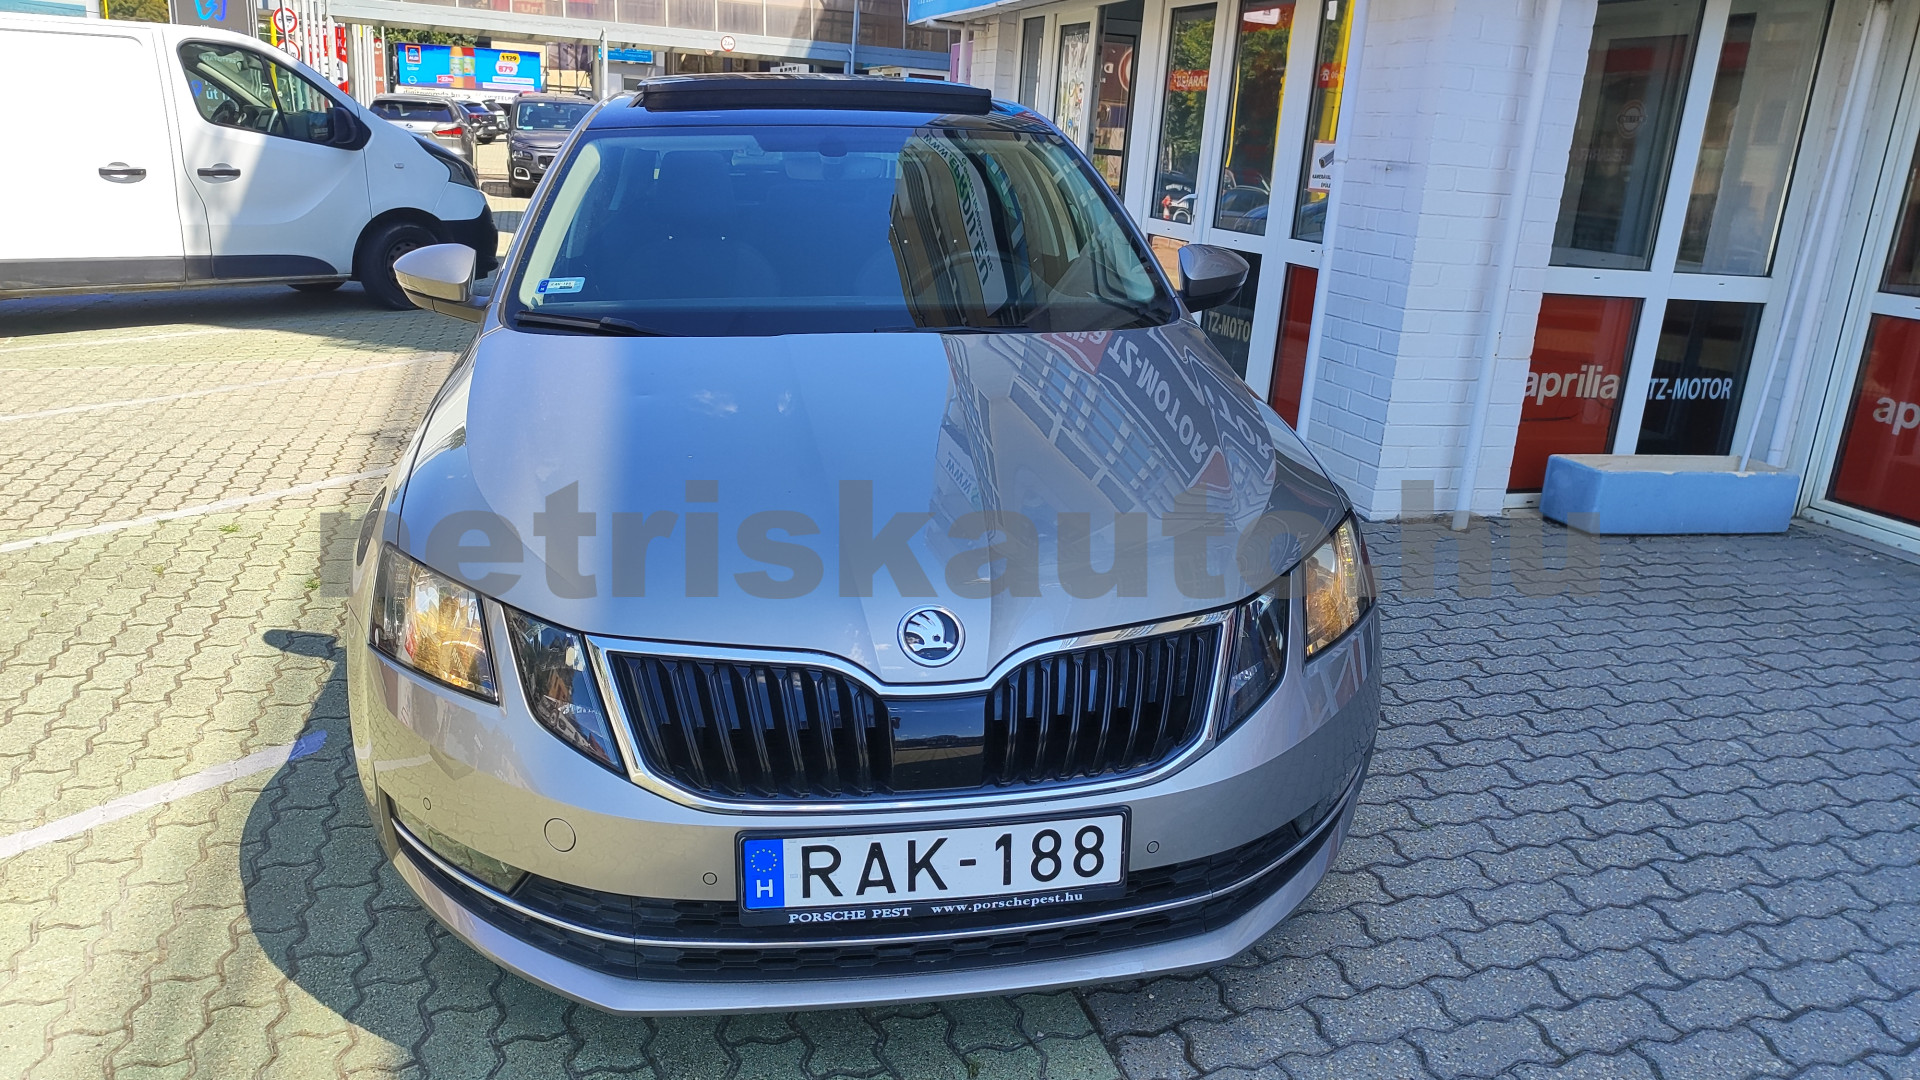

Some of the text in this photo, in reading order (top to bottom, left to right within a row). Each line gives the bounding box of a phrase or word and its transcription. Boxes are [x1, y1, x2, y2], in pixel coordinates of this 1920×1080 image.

[1208, 311, 1250, 342] TZ-MOTO
[1524, 364, 1621, 406] aprilia
[1648, 377, 1734, 401] TZ-MOTOR
[1872, 397, 1920, 436] ap
[801, 825, 1105, 899] RAK-188
[756, 879, 774, 898] H
[788, 892, 1084, 924] PORSCHE PEST www.porschepest.hu
